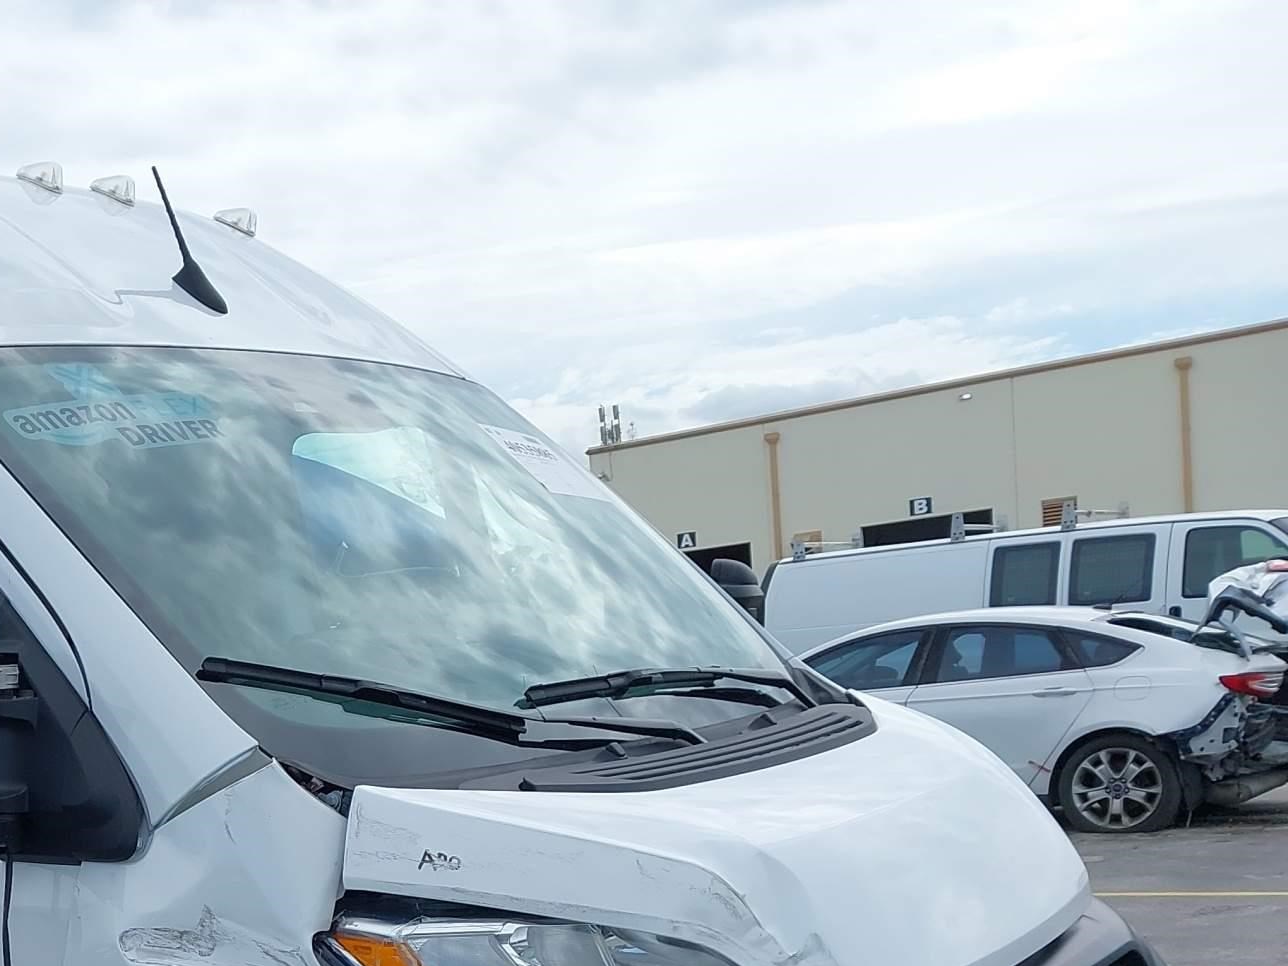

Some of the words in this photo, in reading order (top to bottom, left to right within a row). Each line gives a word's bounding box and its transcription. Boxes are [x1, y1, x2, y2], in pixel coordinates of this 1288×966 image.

[13, 401, 137, 434] amazon
[116, 419, 227, 447] DRIVER
[913, 499, 929, 515] B
[680, 533, 694, 548] A
